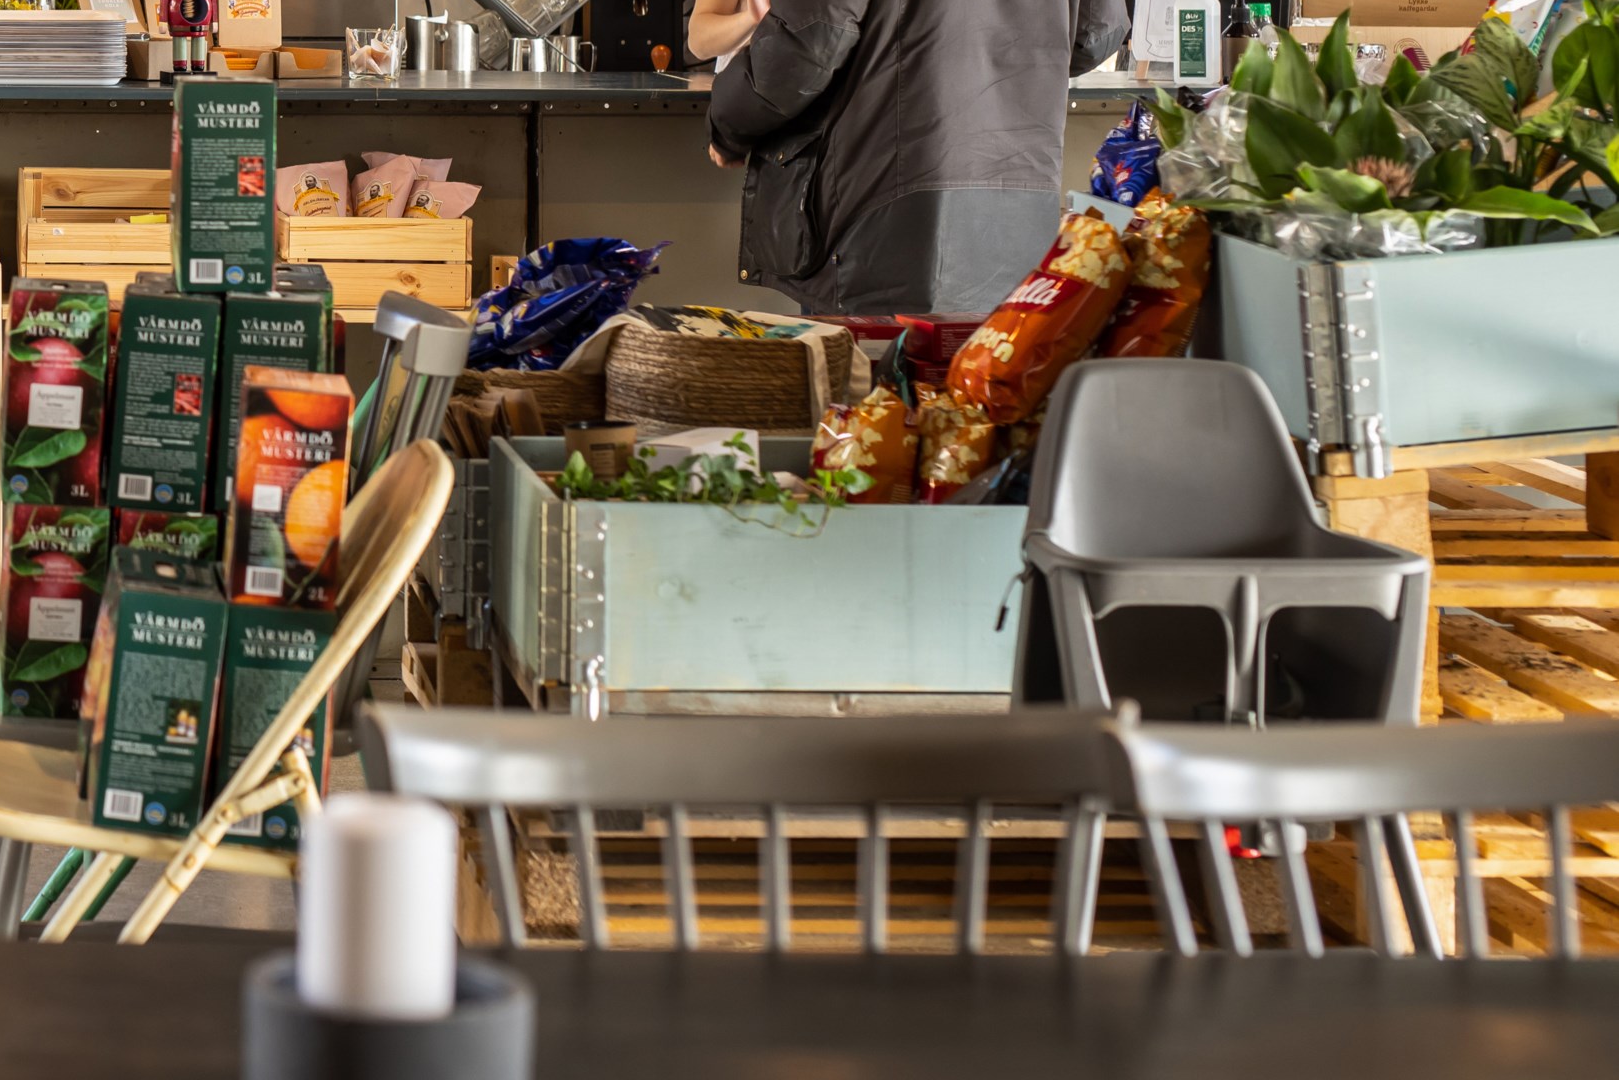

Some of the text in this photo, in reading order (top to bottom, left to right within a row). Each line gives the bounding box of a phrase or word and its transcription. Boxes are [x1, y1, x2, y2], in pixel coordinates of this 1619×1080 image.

[1181, 25, 1196, 33] DES
[197, 101, 261, 114] VÄRMDÖ
[197, 117, 260, 129] MUSTERI
[247, 272, 266, 284] 3L
[137, 331, 201, 347] MUSTERI
[240, 333, 304, 348] MUSTERI
[260, 446, 332, 462] MUSTERI
[131, 629, 203, 650] MUSTERI
[243, 643, 315, 662] MUSTERI
